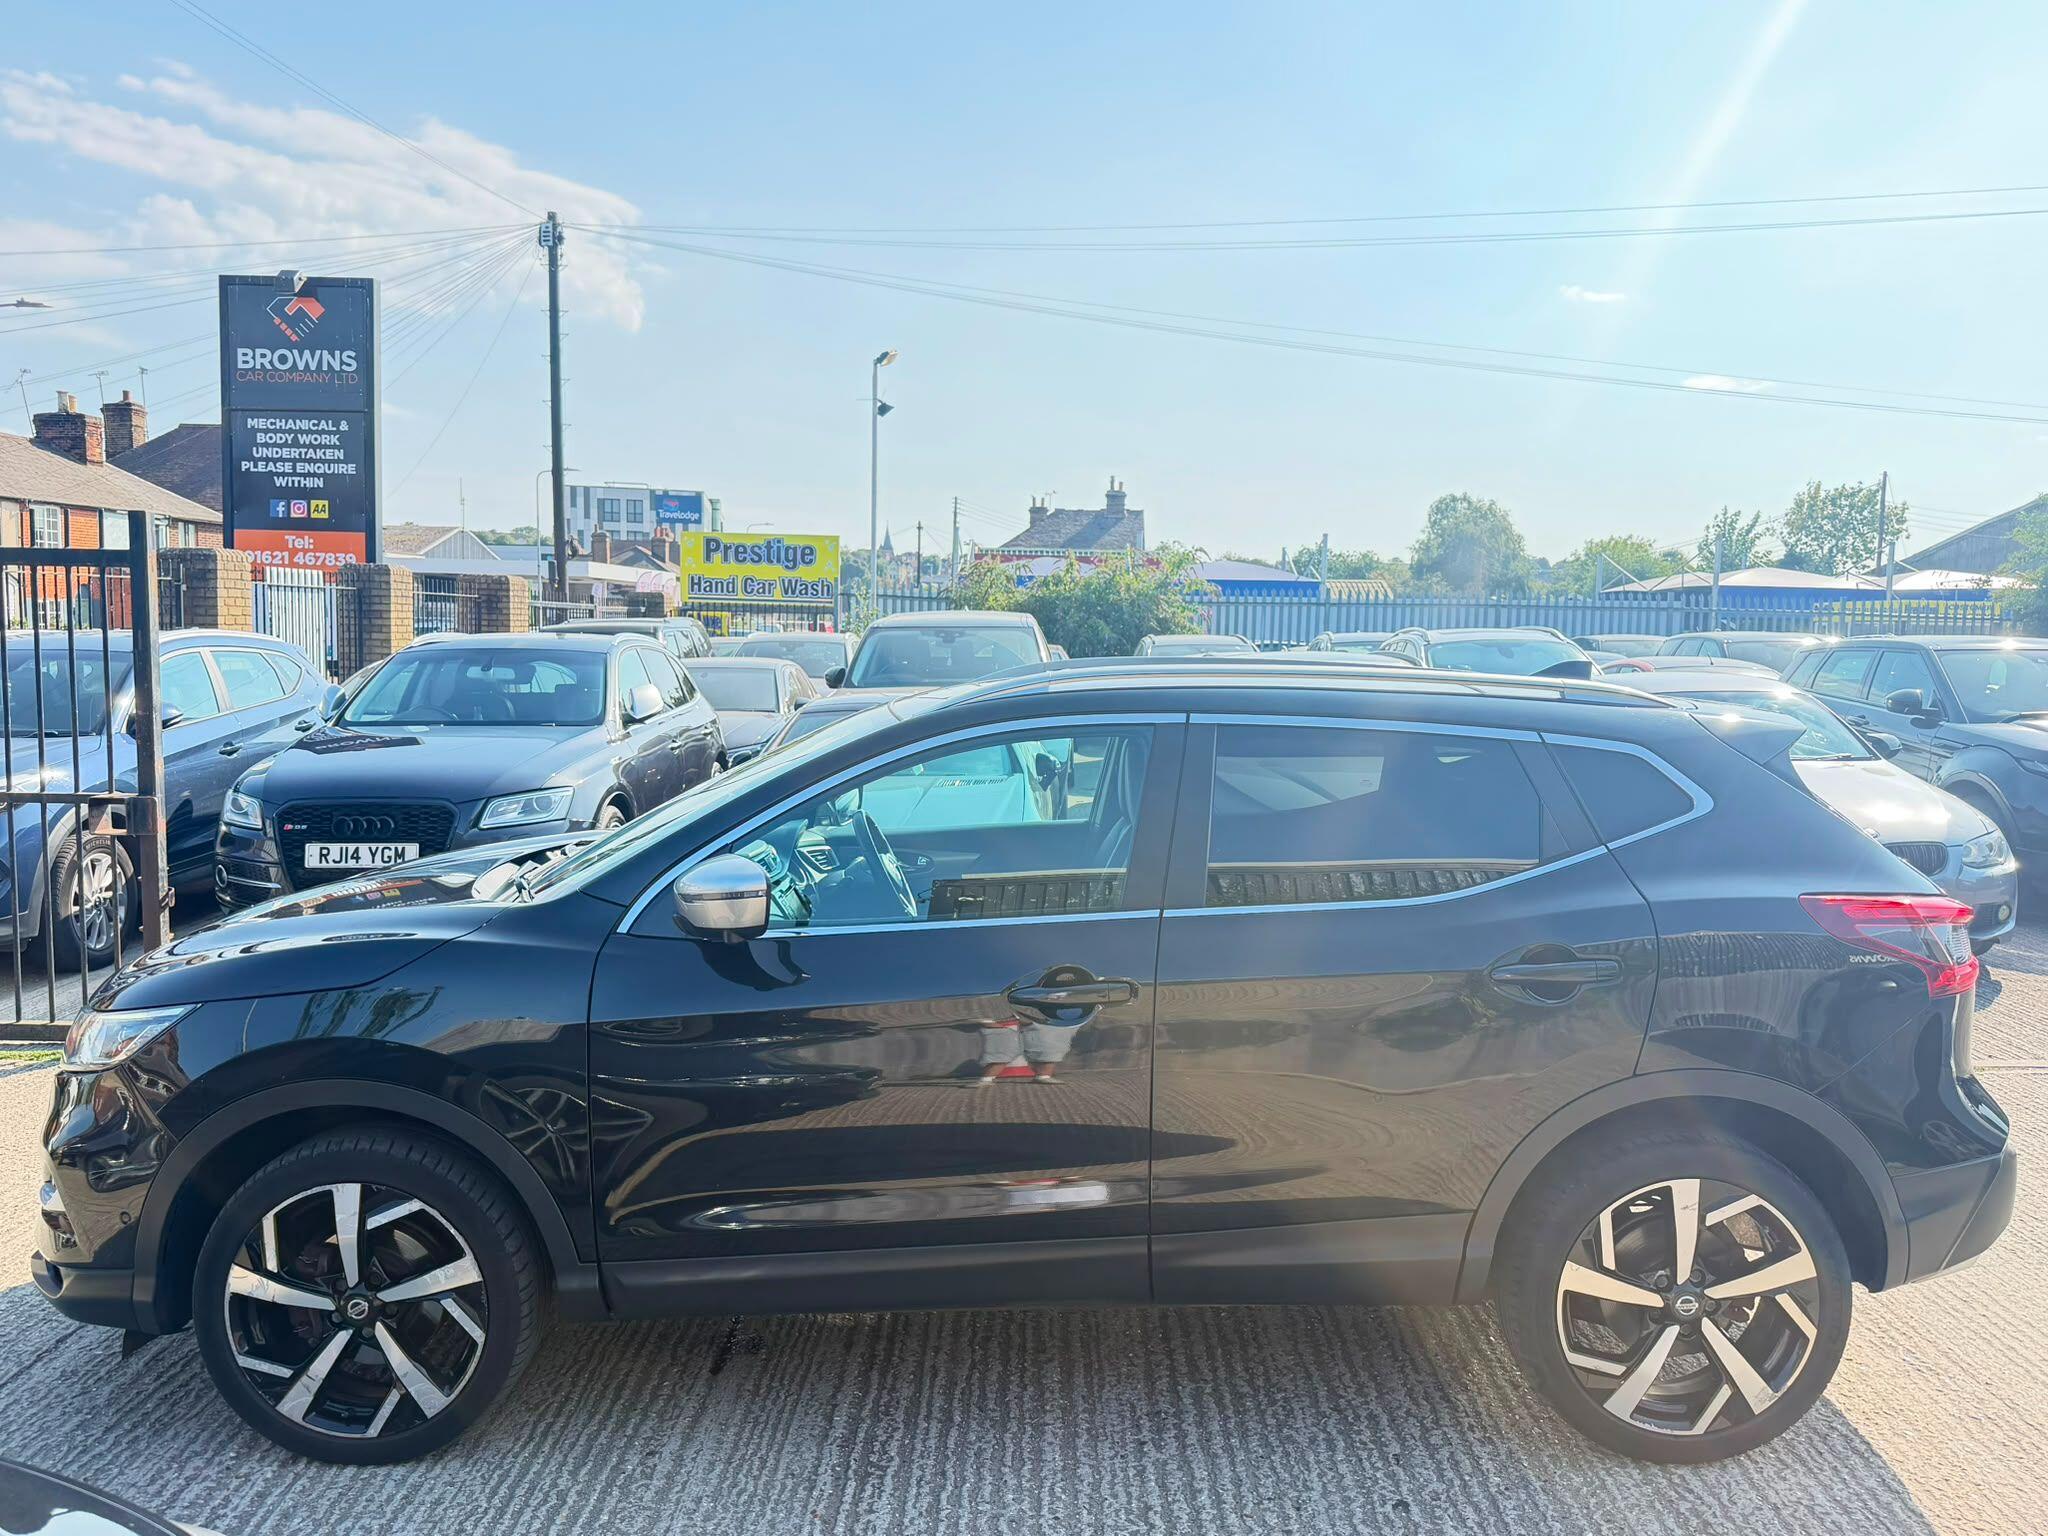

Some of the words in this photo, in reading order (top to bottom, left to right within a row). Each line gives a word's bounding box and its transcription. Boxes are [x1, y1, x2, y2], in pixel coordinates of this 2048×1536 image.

[236, 348, 357, 372] BROWNS
[236, 371, 264, 382] CAR
[266, 371, 331, 384] COMPANY
[334, 373, 358, 384] LTD
[247, 418, 336, 431] MECHANICAL
[339, 420, 349, 431] &
[256, 433, 294, 444] BODY
[297, 434, 340, 445] WORK
[252, 447, 344, 460] UNDERTAKEN
[241, 461, 293, 473] PLEASE
[296, 463, 357, 474] ENQUIRE
[274, 476, 324, 488] WITHIN
[312, 504, 327, 514] AA
[657, 509, 700, 521] Travelodge
[285, 535, 314, 549] Tel:
[294, 551, 357, 566] 467839
[703, 536, 816, 570] Prestige
[688, 574, 737, 596] Hand
[741, 575, 776, 597] Car
[778, 576, 834, 599] Wash
[318, 846, 361, 865] RJ14
[369, 846, 406, 864] YGM
